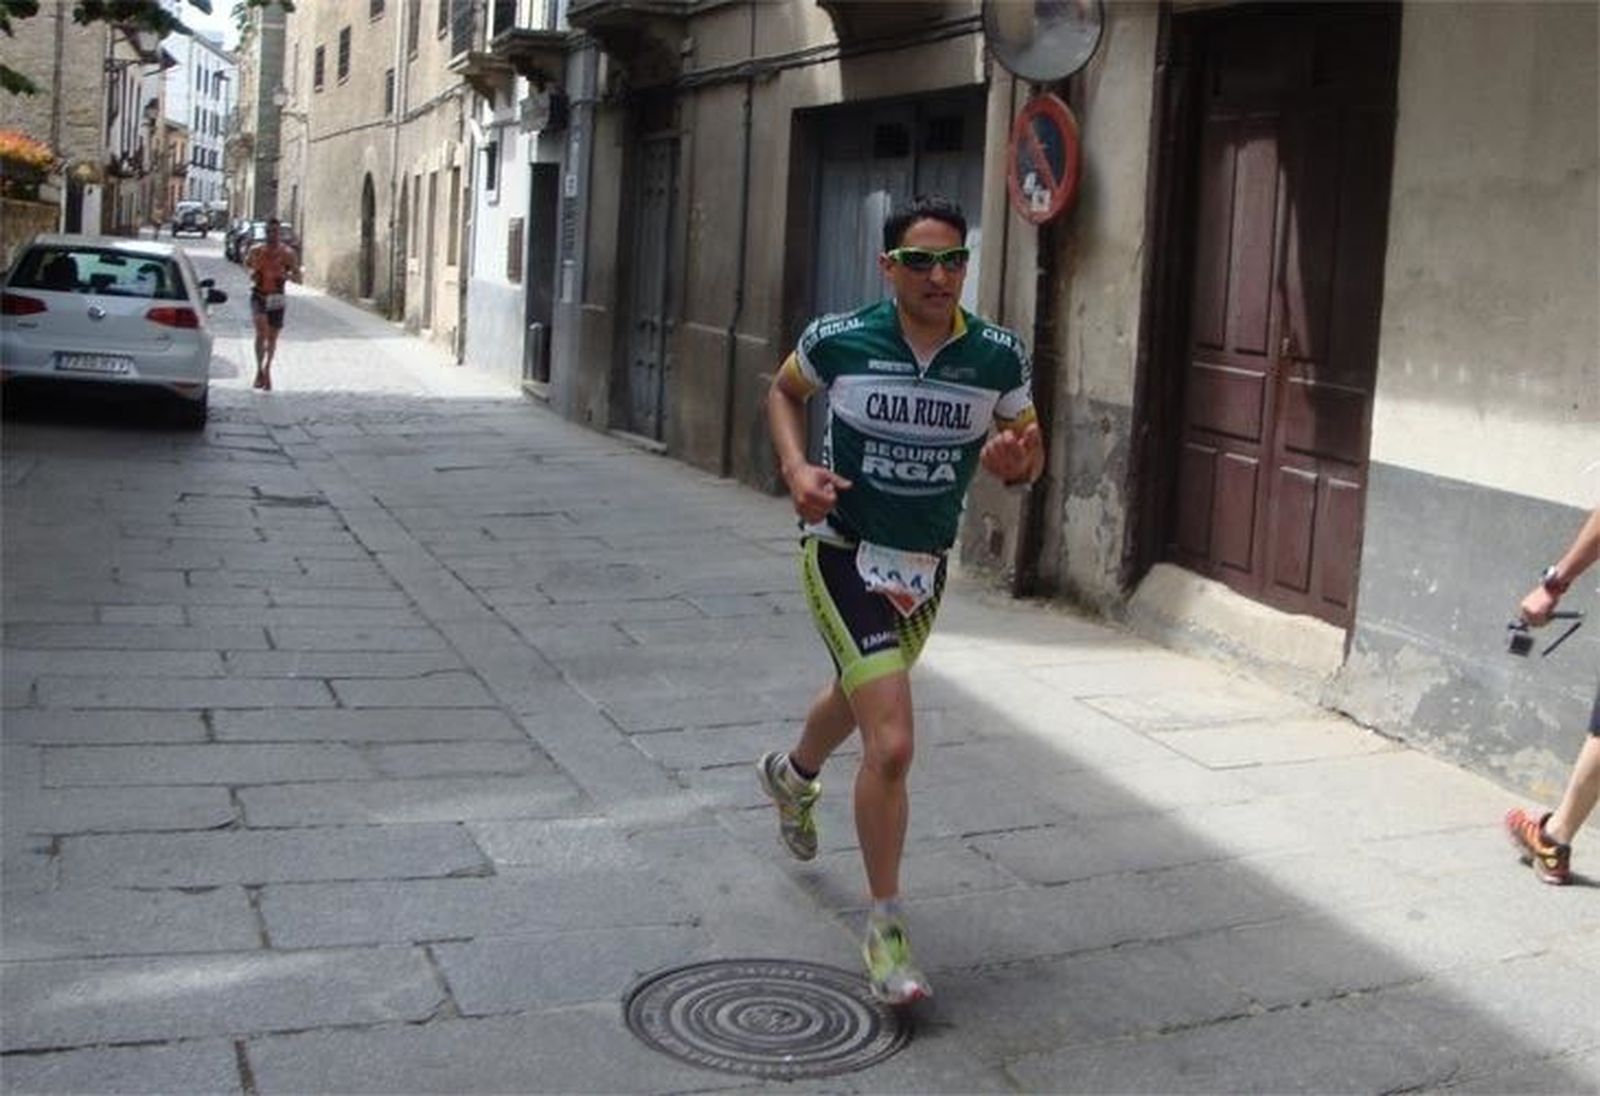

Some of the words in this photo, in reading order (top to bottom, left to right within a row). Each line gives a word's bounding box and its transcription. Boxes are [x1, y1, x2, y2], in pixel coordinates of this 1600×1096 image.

[866, 392, 909, 424] CAJA
[912, 395, 972, 430] RURAL
[863, 440, 962, 462] SEGUROS
[862, 455, 956, 482] RGA
